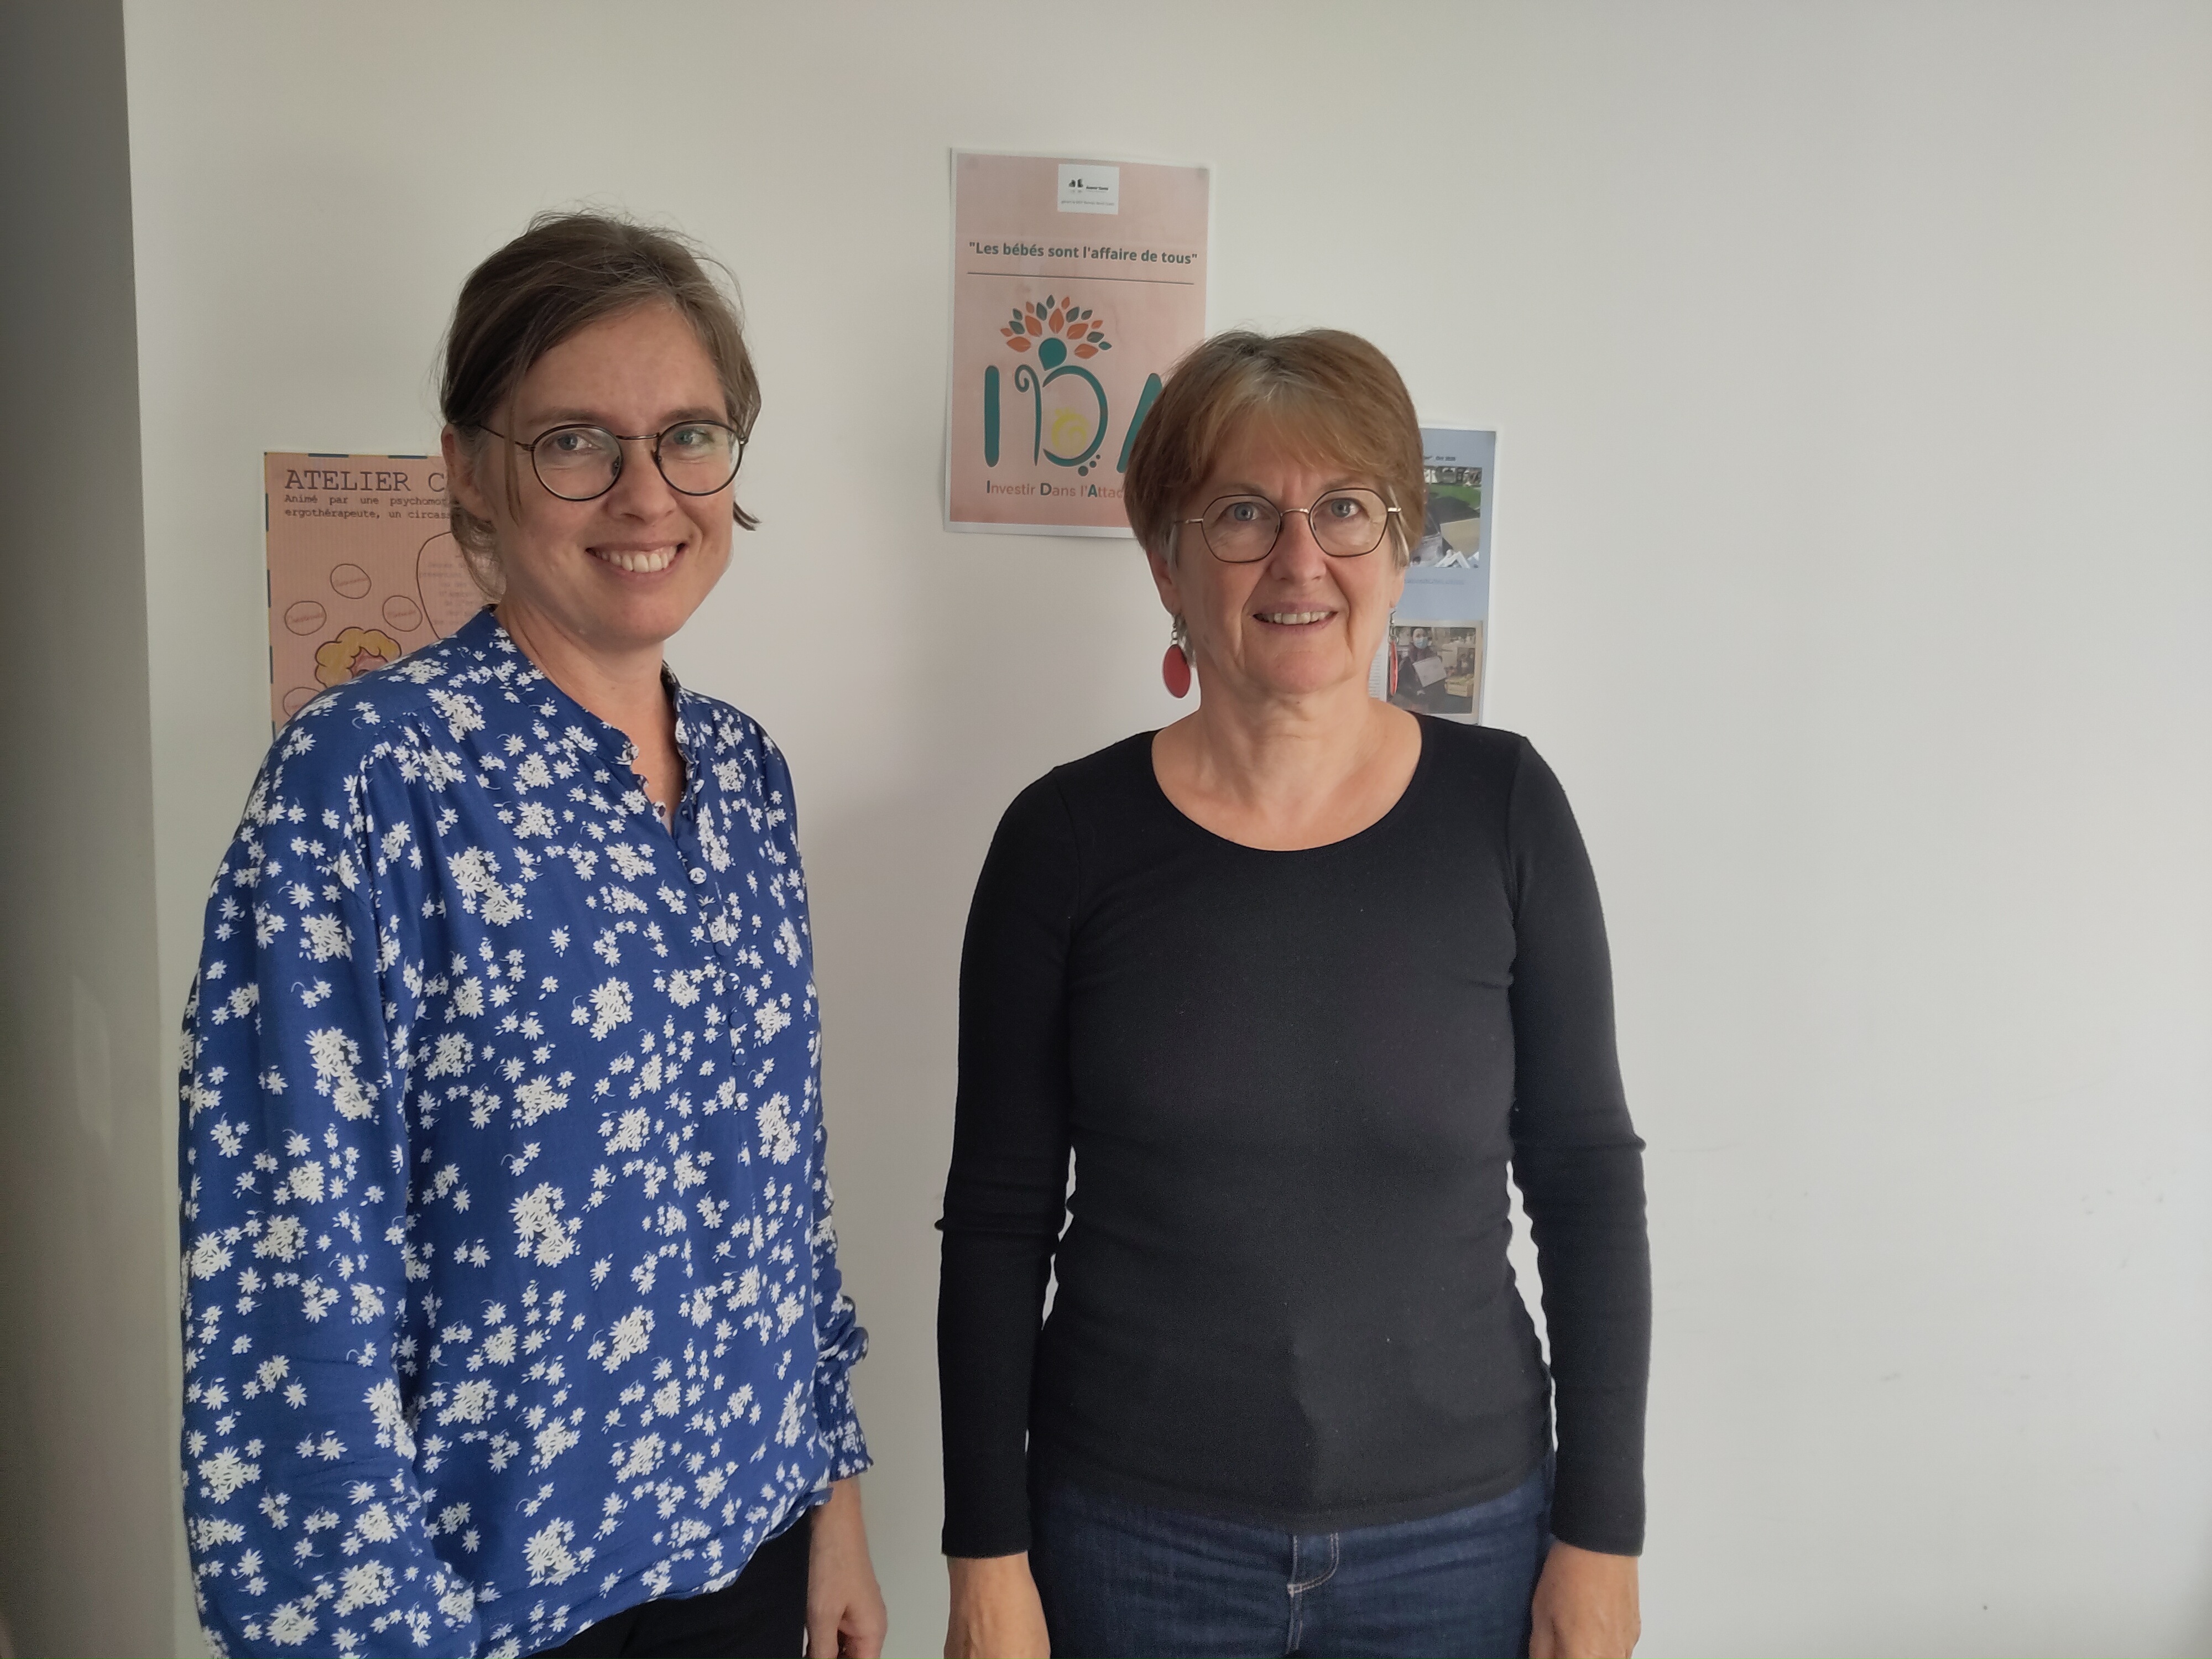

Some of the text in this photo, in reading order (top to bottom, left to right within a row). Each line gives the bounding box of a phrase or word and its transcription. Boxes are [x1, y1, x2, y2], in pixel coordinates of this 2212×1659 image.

[969, 242, 1198, 264] "Les bébés sont l'affaire de tous"
[285, 470, 445, 492] ATELIER C
[987, 480, 1123, 498] Investir Dans l'Attac
[284, 495, 318, 503] Animé
[330, 497, 348, 505] par
[390, 497, 448, 507] psychomot
[285, 509, 380, 519] ergothérapeute,
[408, 510, 451, 519] circas
